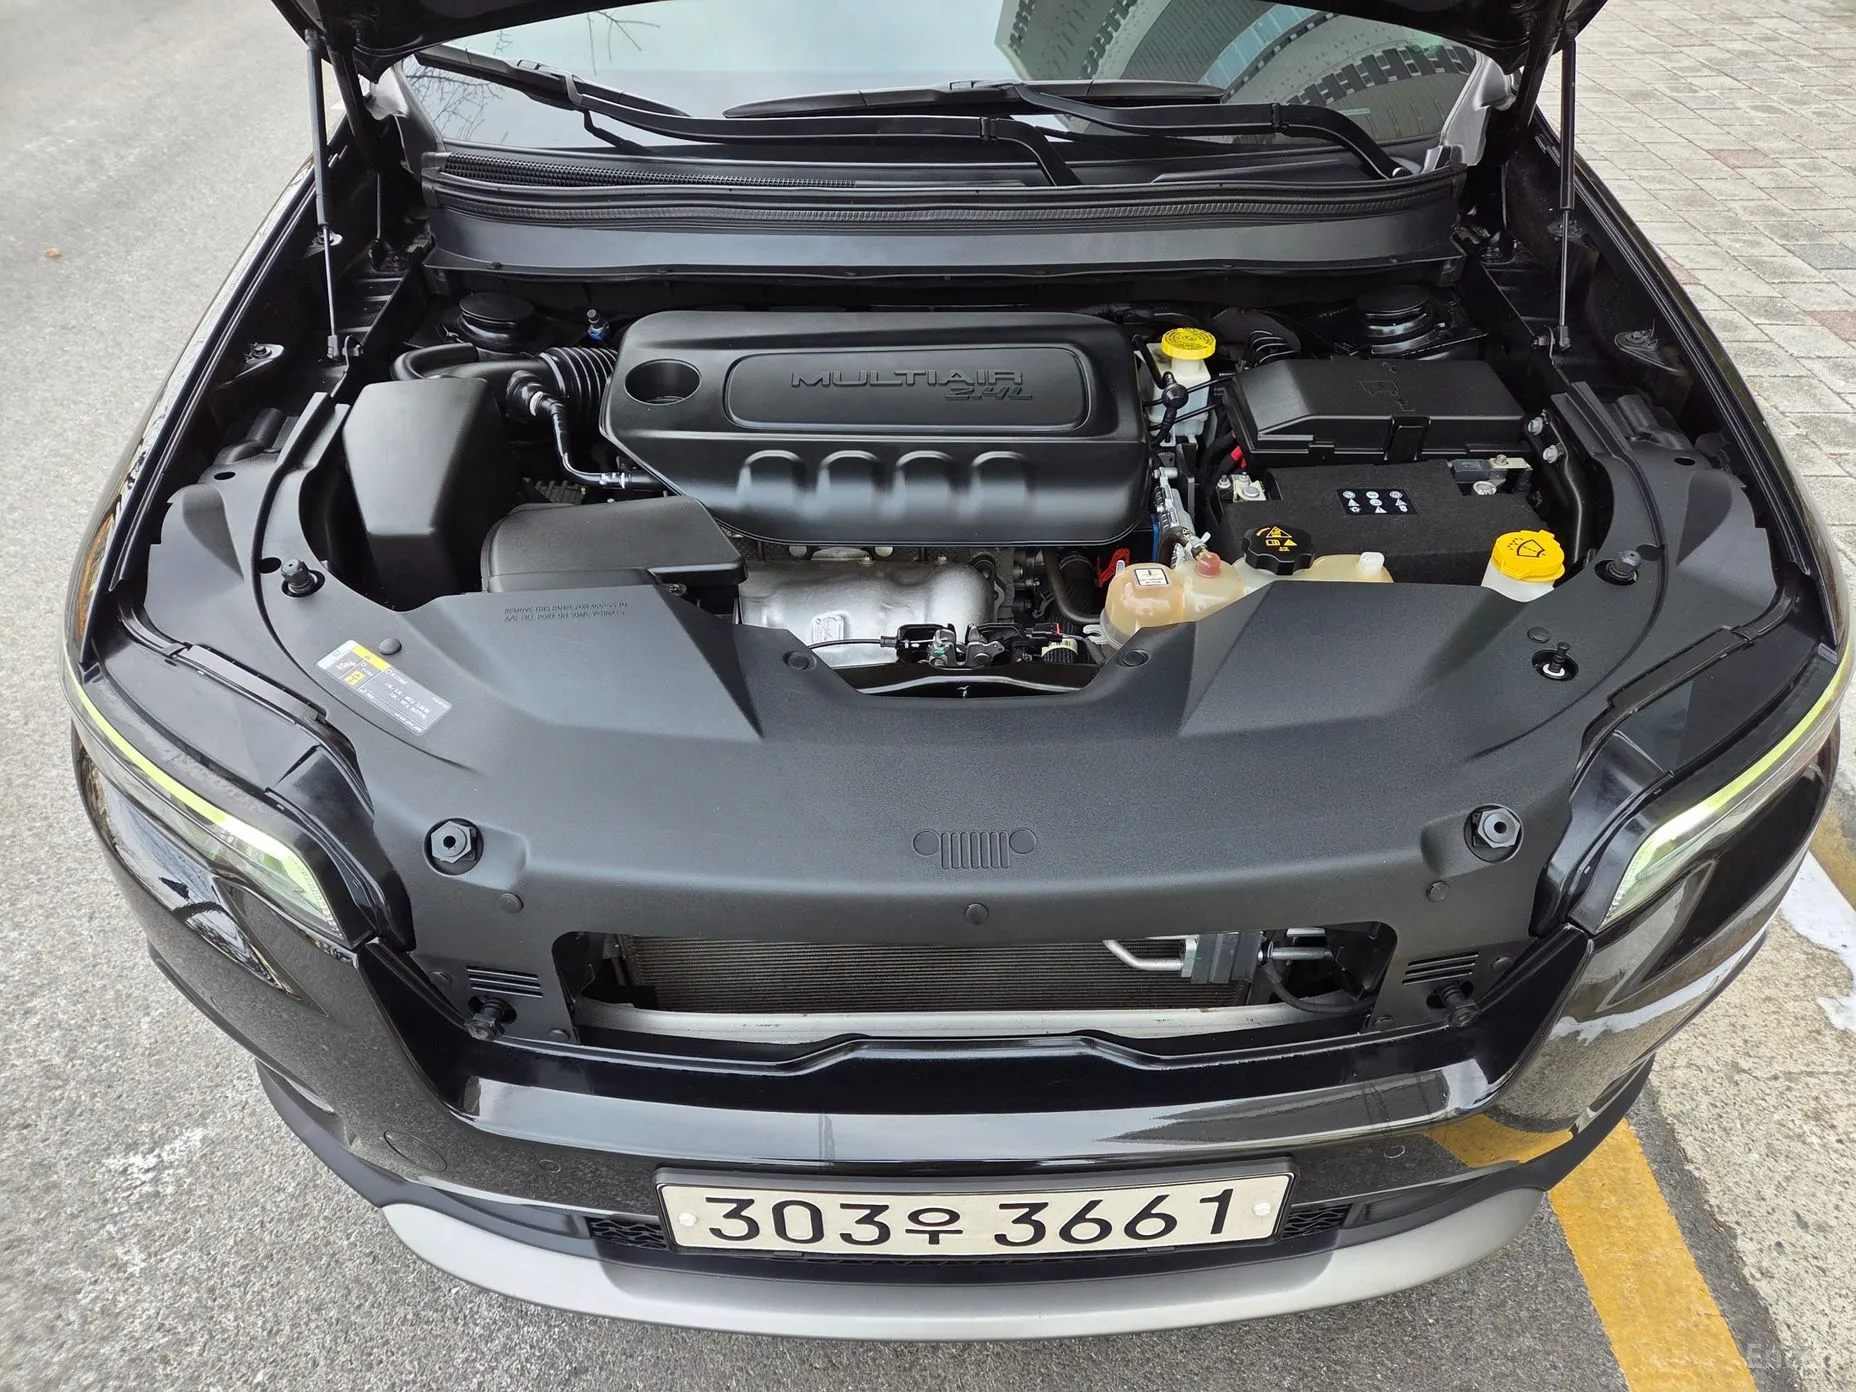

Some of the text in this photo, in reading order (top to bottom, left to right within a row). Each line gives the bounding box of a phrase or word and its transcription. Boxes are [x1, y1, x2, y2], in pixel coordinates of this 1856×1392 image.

[791, 369, 1023, 388] MULTIAIR
[944, 386, 1033, 400] 2.4L
[704, 1188, 1235, 1246] 303우 3661
